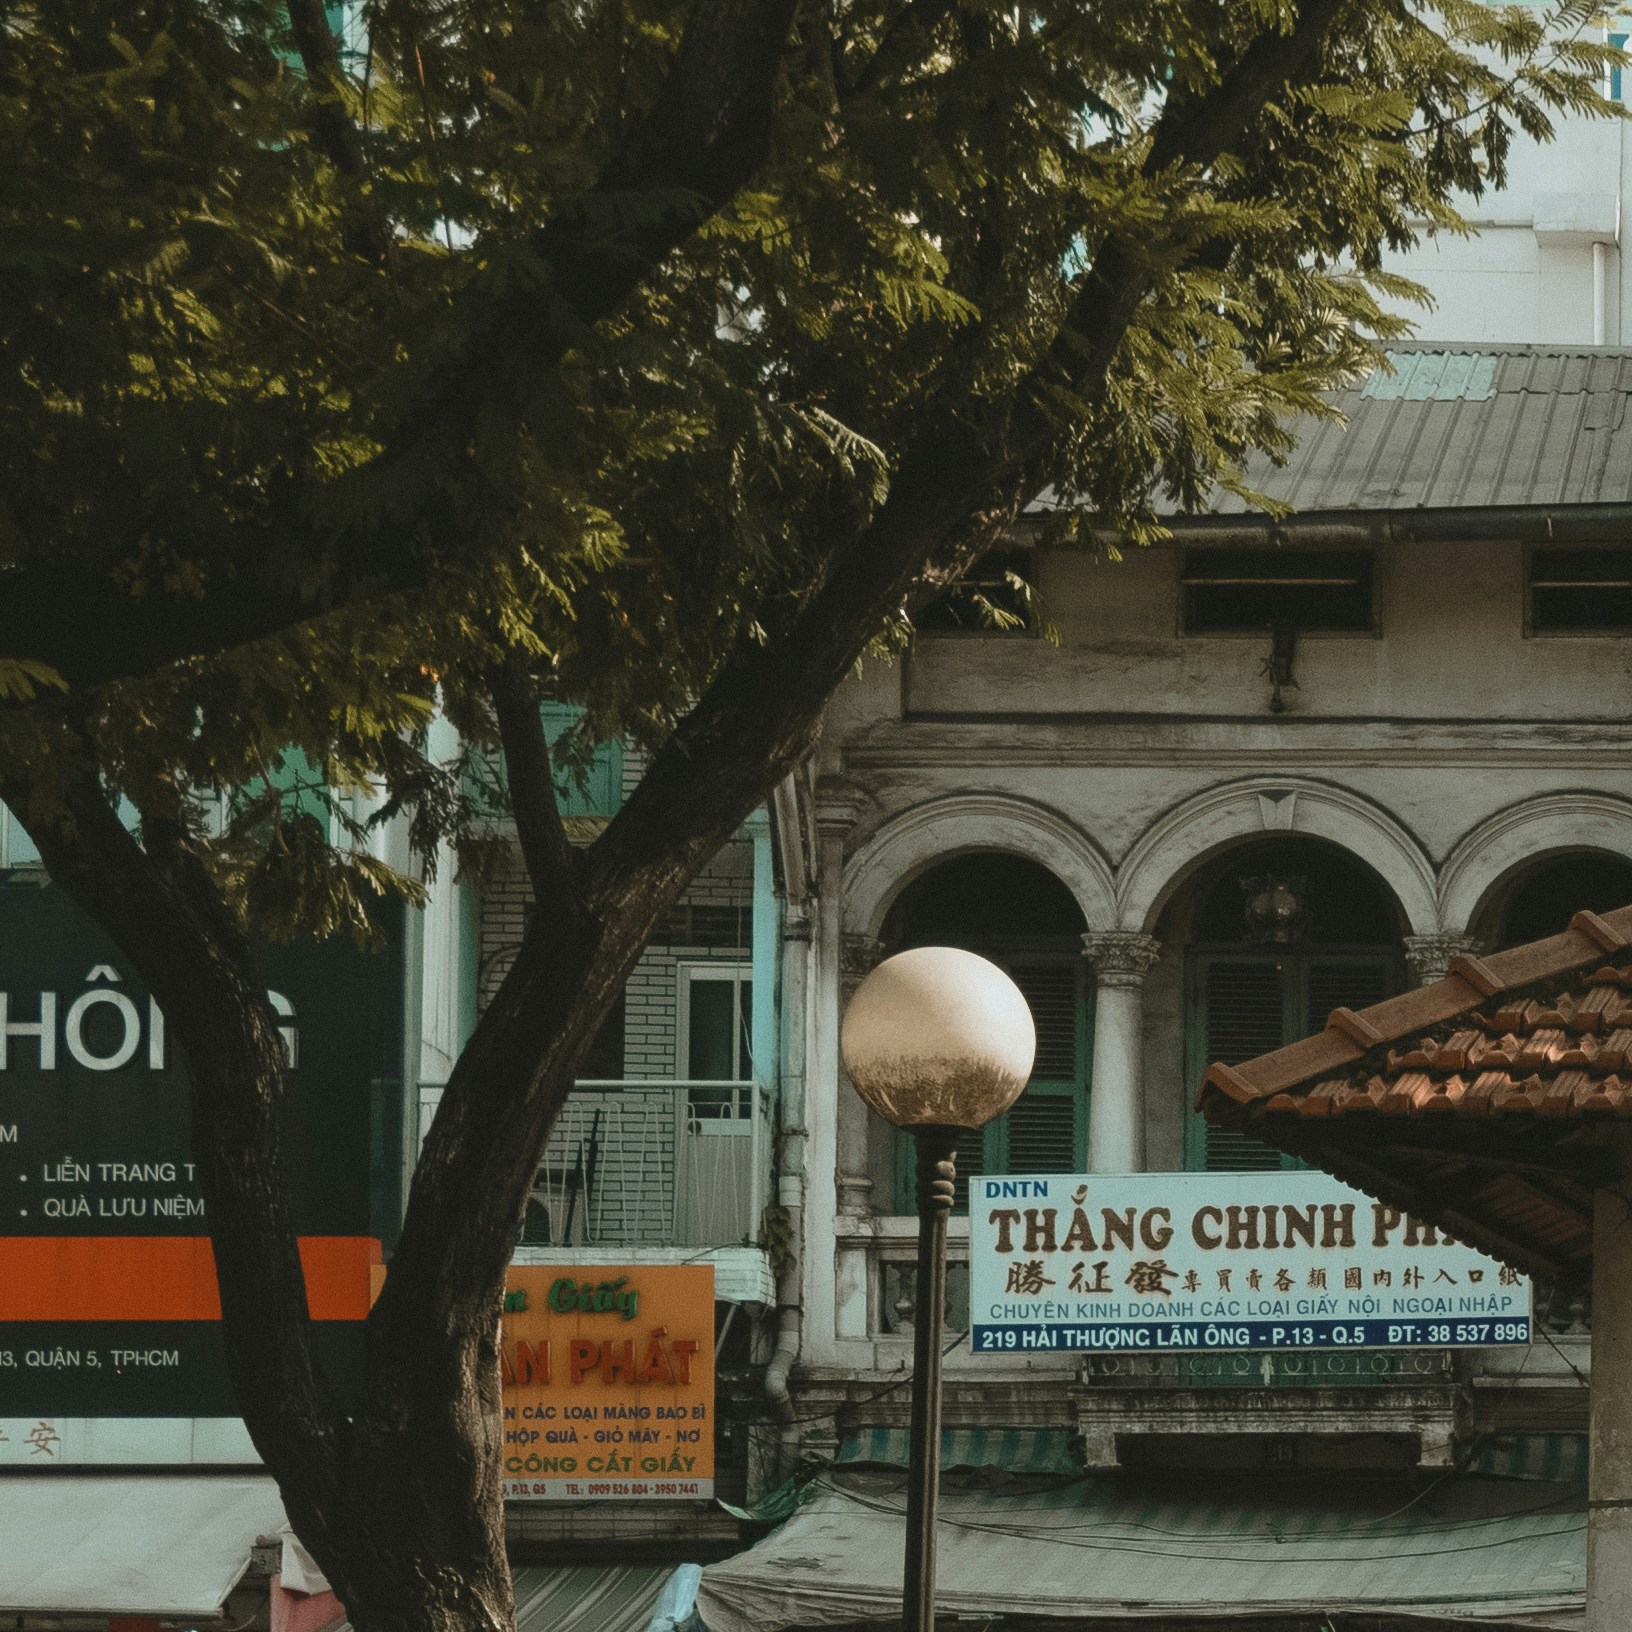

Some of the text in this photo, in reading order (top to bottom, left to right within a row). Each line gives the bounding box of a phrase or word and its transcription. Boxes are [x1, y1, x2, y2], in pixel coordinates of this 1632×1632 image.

[98, 1163, 176, 1183] TRANG
[985, 1180, 1049, 1199] DNTN
[44, 1194, 206, 1220] QUÀ LƯU NIỆM
[988, 1183, 1357, 1254] THẮNG CHINH
[989, 1292, 1513, 1320] CHUYÊN KINH DOANH CÁC LOẠI GIẤY NỘI NGOẠI NHẬP
[982, 1321, 1529, 1350] 219 HẢI THƯỢNG LÃN ÔNG P.13 Q.5 ĐT: 38 537 896
[25, 1346, 180, 1370] QUẬN 5, TPHCM
[569, 1325, 699, 1387] PHÁT
[522, 1402, 557, 1420] CÁC
[563, 1406, 599, 1423] LOẠI
[657, 1406, 688, 1420] BAO
[506, 1427, 541, 1447] HỘP
[546, 1425, 579, 1444] QUÀ
[504, 1453, 579, 1474] CÔNG
[640, 1447, 698, 1474] GIẤY
